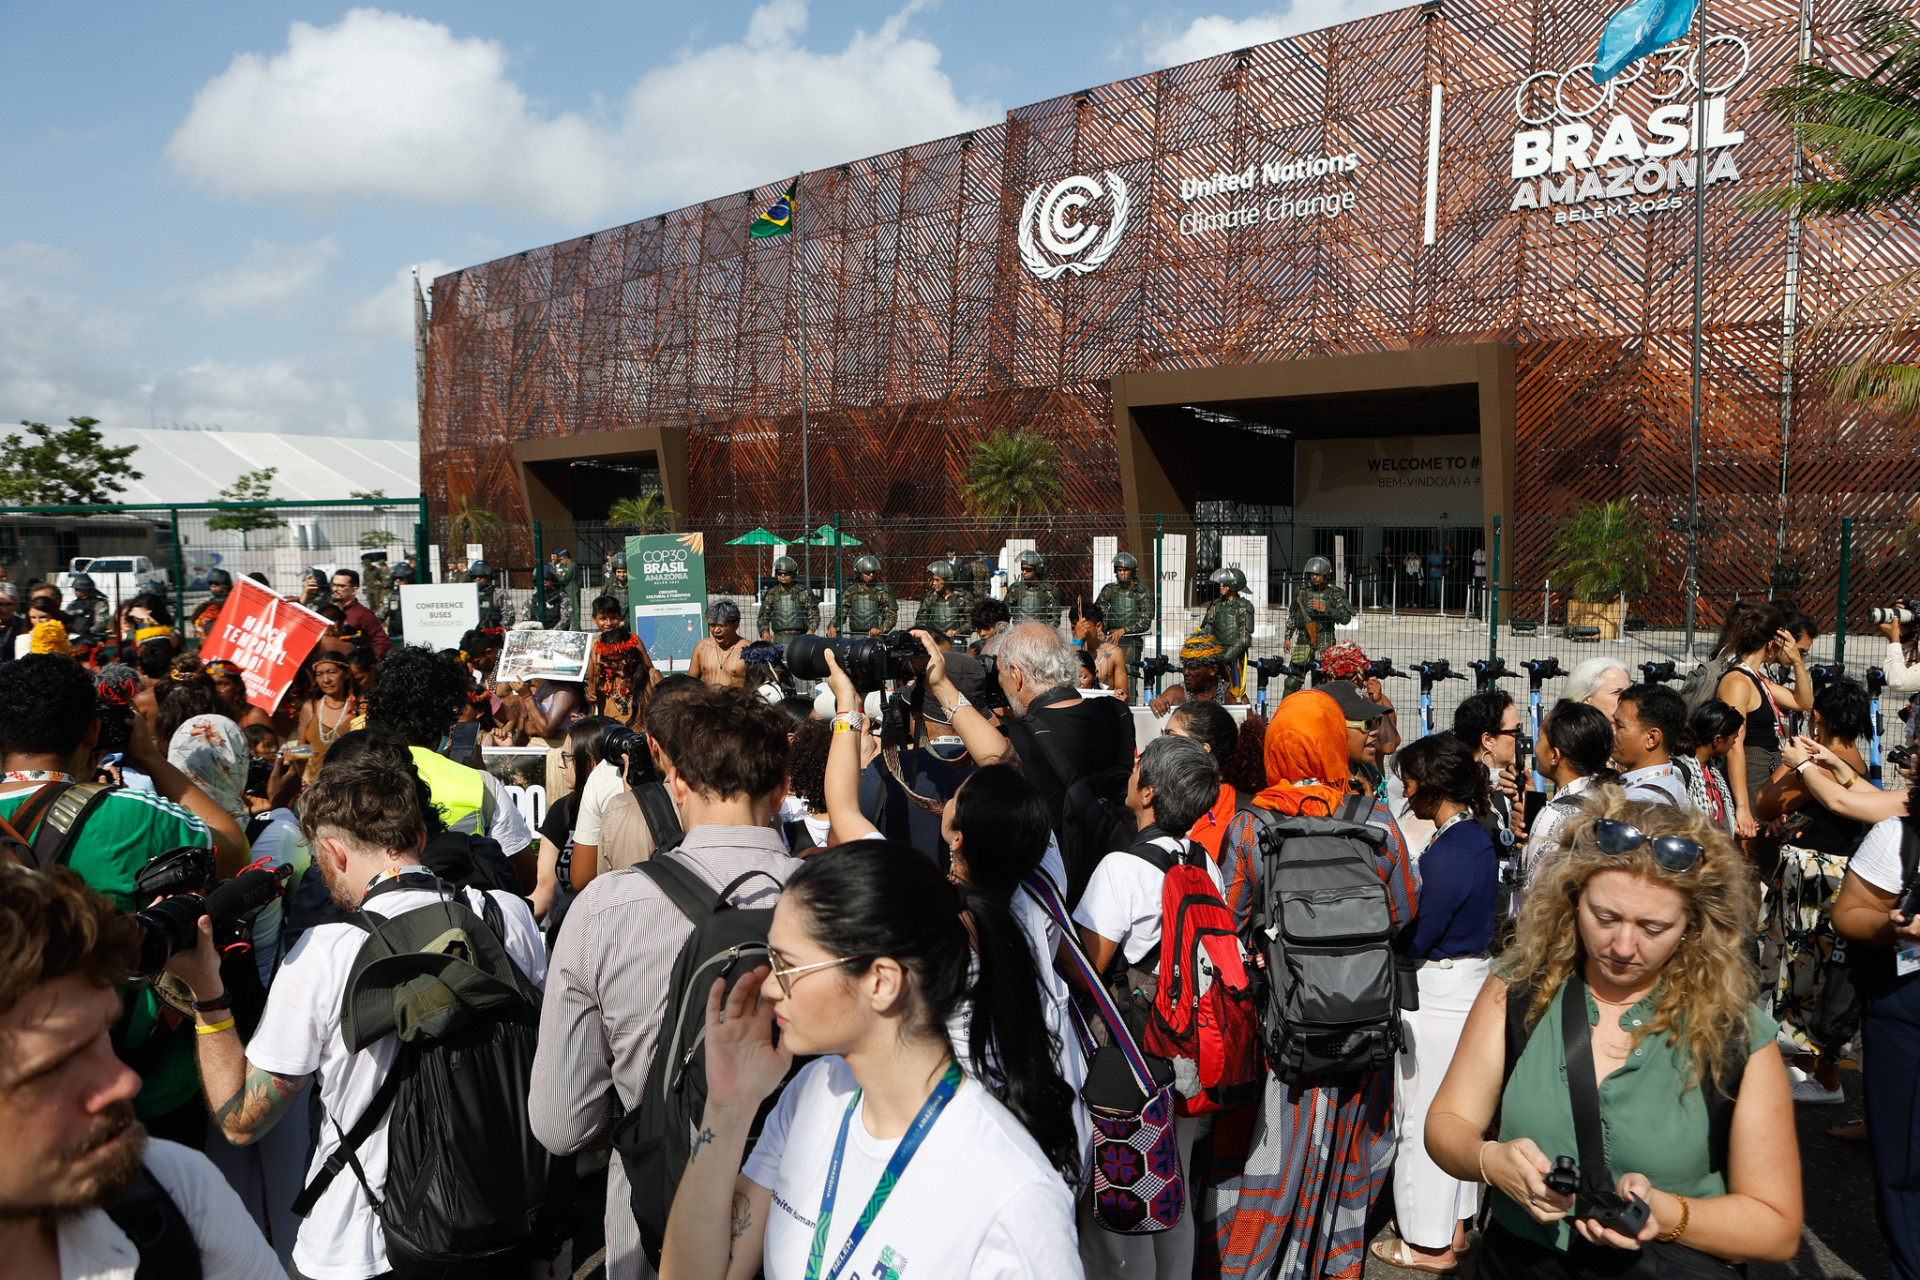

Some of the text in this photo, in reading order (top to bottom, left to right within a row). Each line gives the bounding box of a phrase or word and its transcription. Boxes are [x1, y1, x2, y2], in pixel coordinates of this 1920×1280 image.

[1516, 35, 1750, 124] COP30
[1511, 97, 1745, 179] BRASIL
[1181, 153, 1358, 200] United Nations
[1510, 152, 1741, 211] AMAZÔNIA
[1180, 191, 1356, 236] Climate Change
[1628, 197, 1683, 215] 2025
[1368, 458, 1442, 471] WELCOME
[1446, 457, 1467, 469] TO
[1378, 476, 1460, 488] BEM-VINDO(A)
[1463, 477, 1471, 487] A
[643, 549, 688, 562] COP30
[643, 562, 688, 574] BRASIL
[645, 573, 688, 582] AMAZÔNIA
[1161, 571, 1178, 580] VIP
[242, 615, 287, 644] MARCO
[222, 624, 287, 665] TEMPORAL
[230, 646, 264, 672] NÃO!
